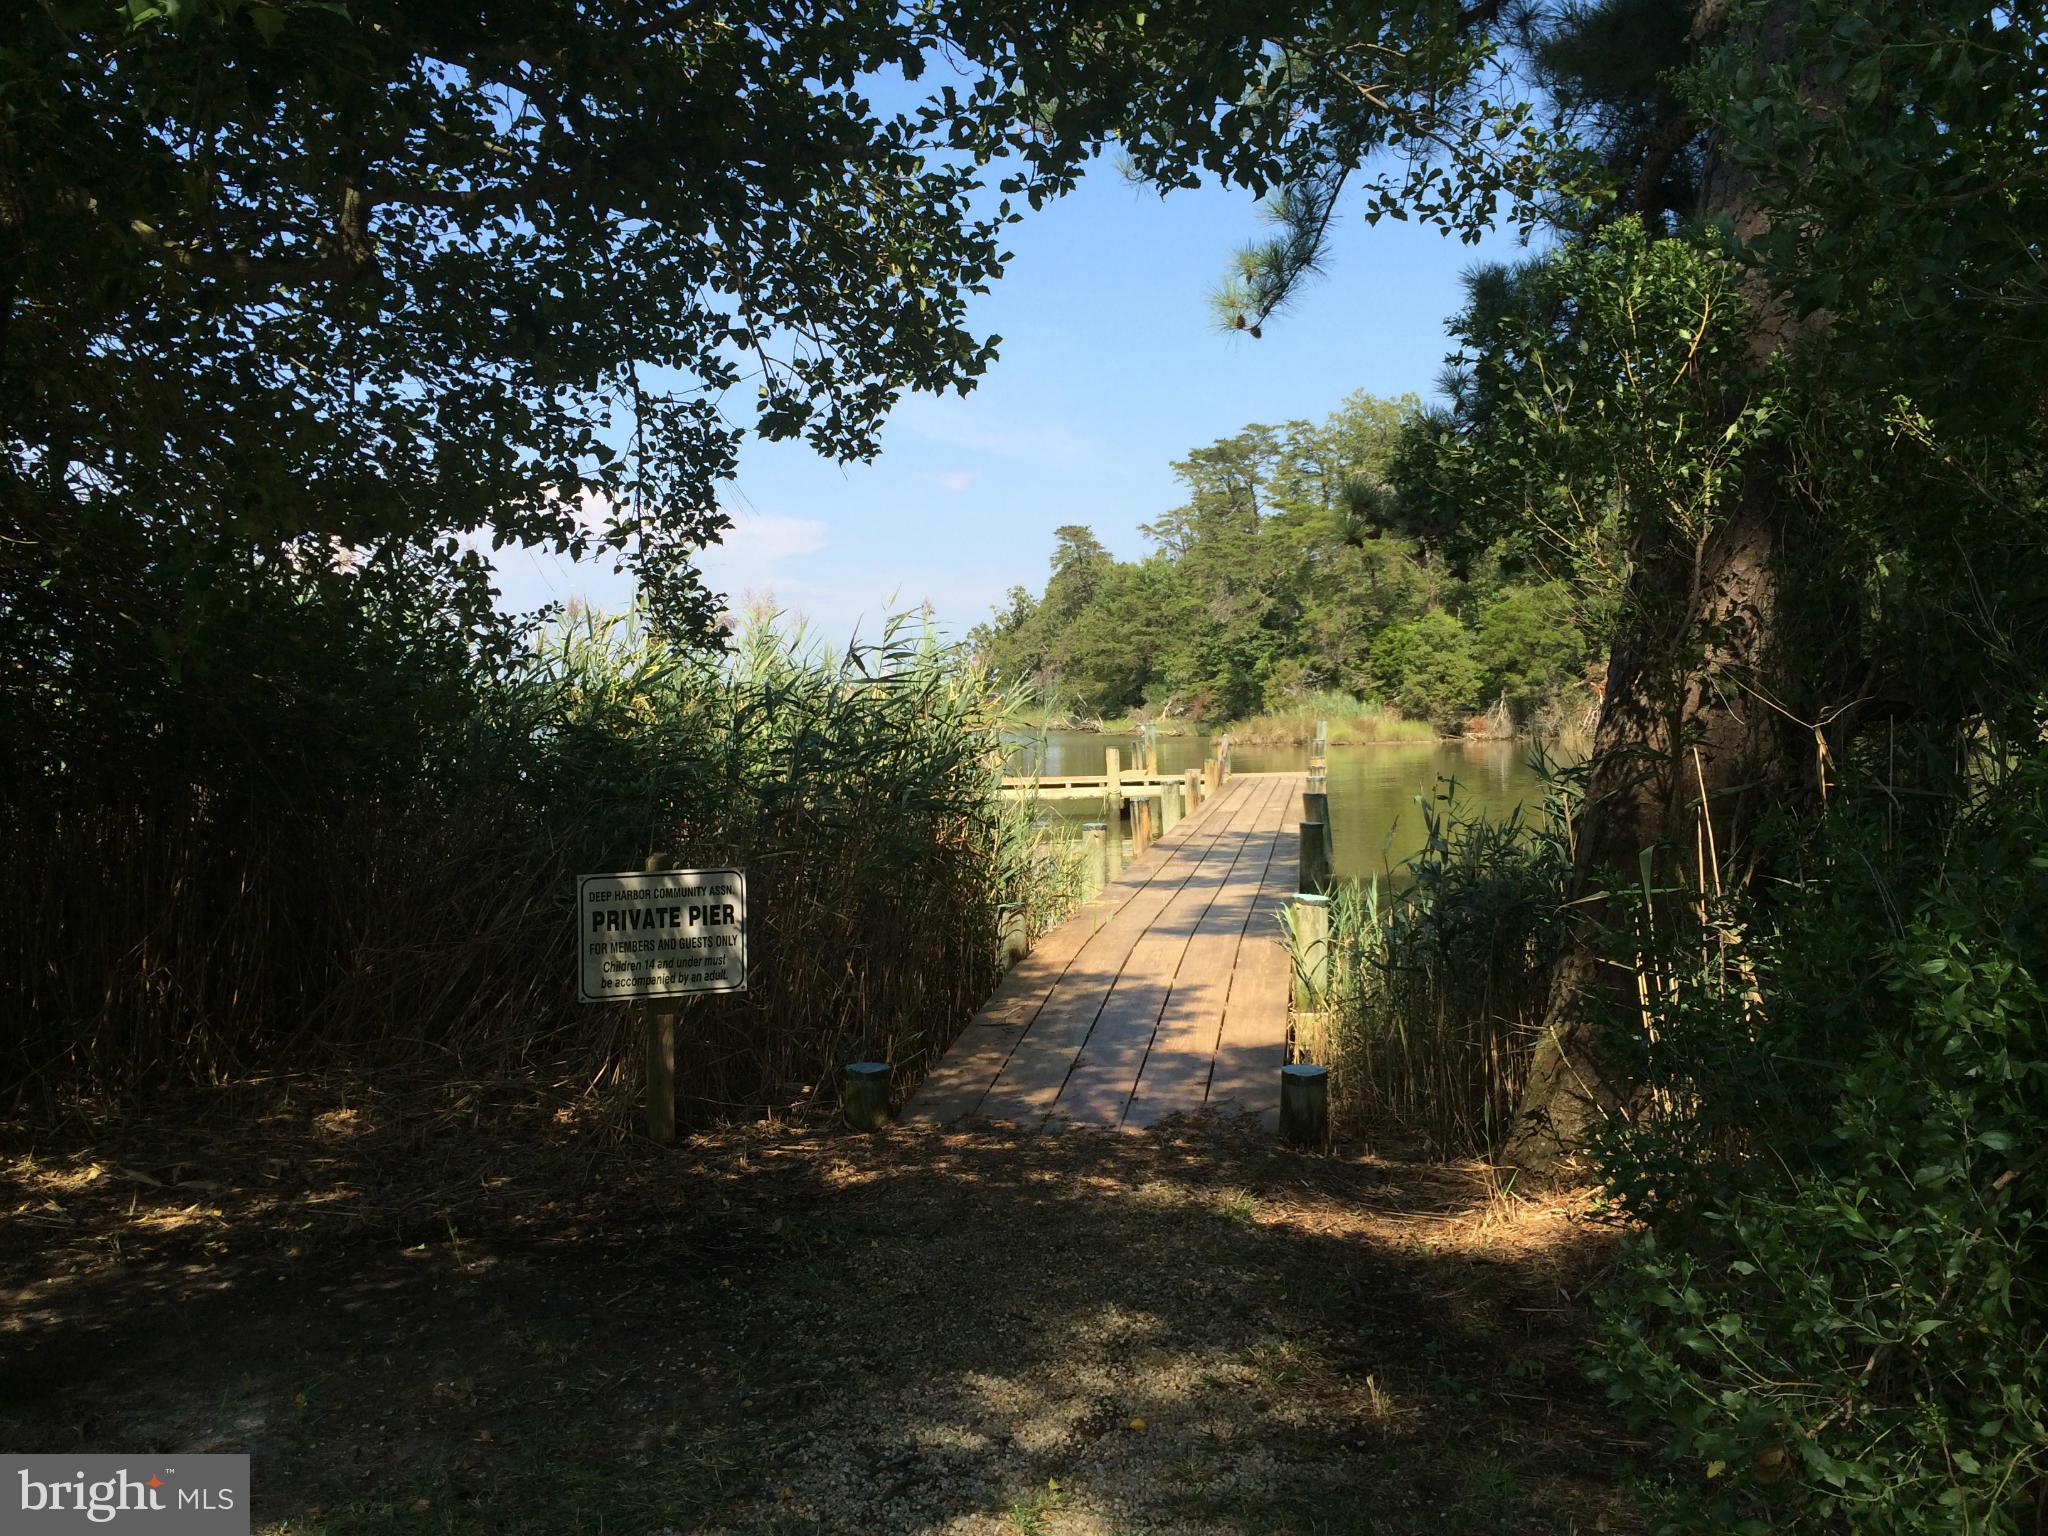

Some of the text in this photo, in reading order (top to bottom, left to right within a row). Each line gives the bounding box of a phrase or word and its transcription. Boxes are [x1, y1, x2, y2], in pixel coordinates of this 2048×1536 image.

[589, 891, 612, 902] DEEP
[614, 888, 651, 901] HARBOR
[653, 886, 707, 899] COMMUNITY
[592, 904, 734, 932] PRIVATE PIER
[590, 934, 738, 955] FOR MEMBERS AND GUESTS ONLY
[603, 953, 726, 973] Children 14 and under must
[601, 969, 728, 988] be accompanied by an adult.
